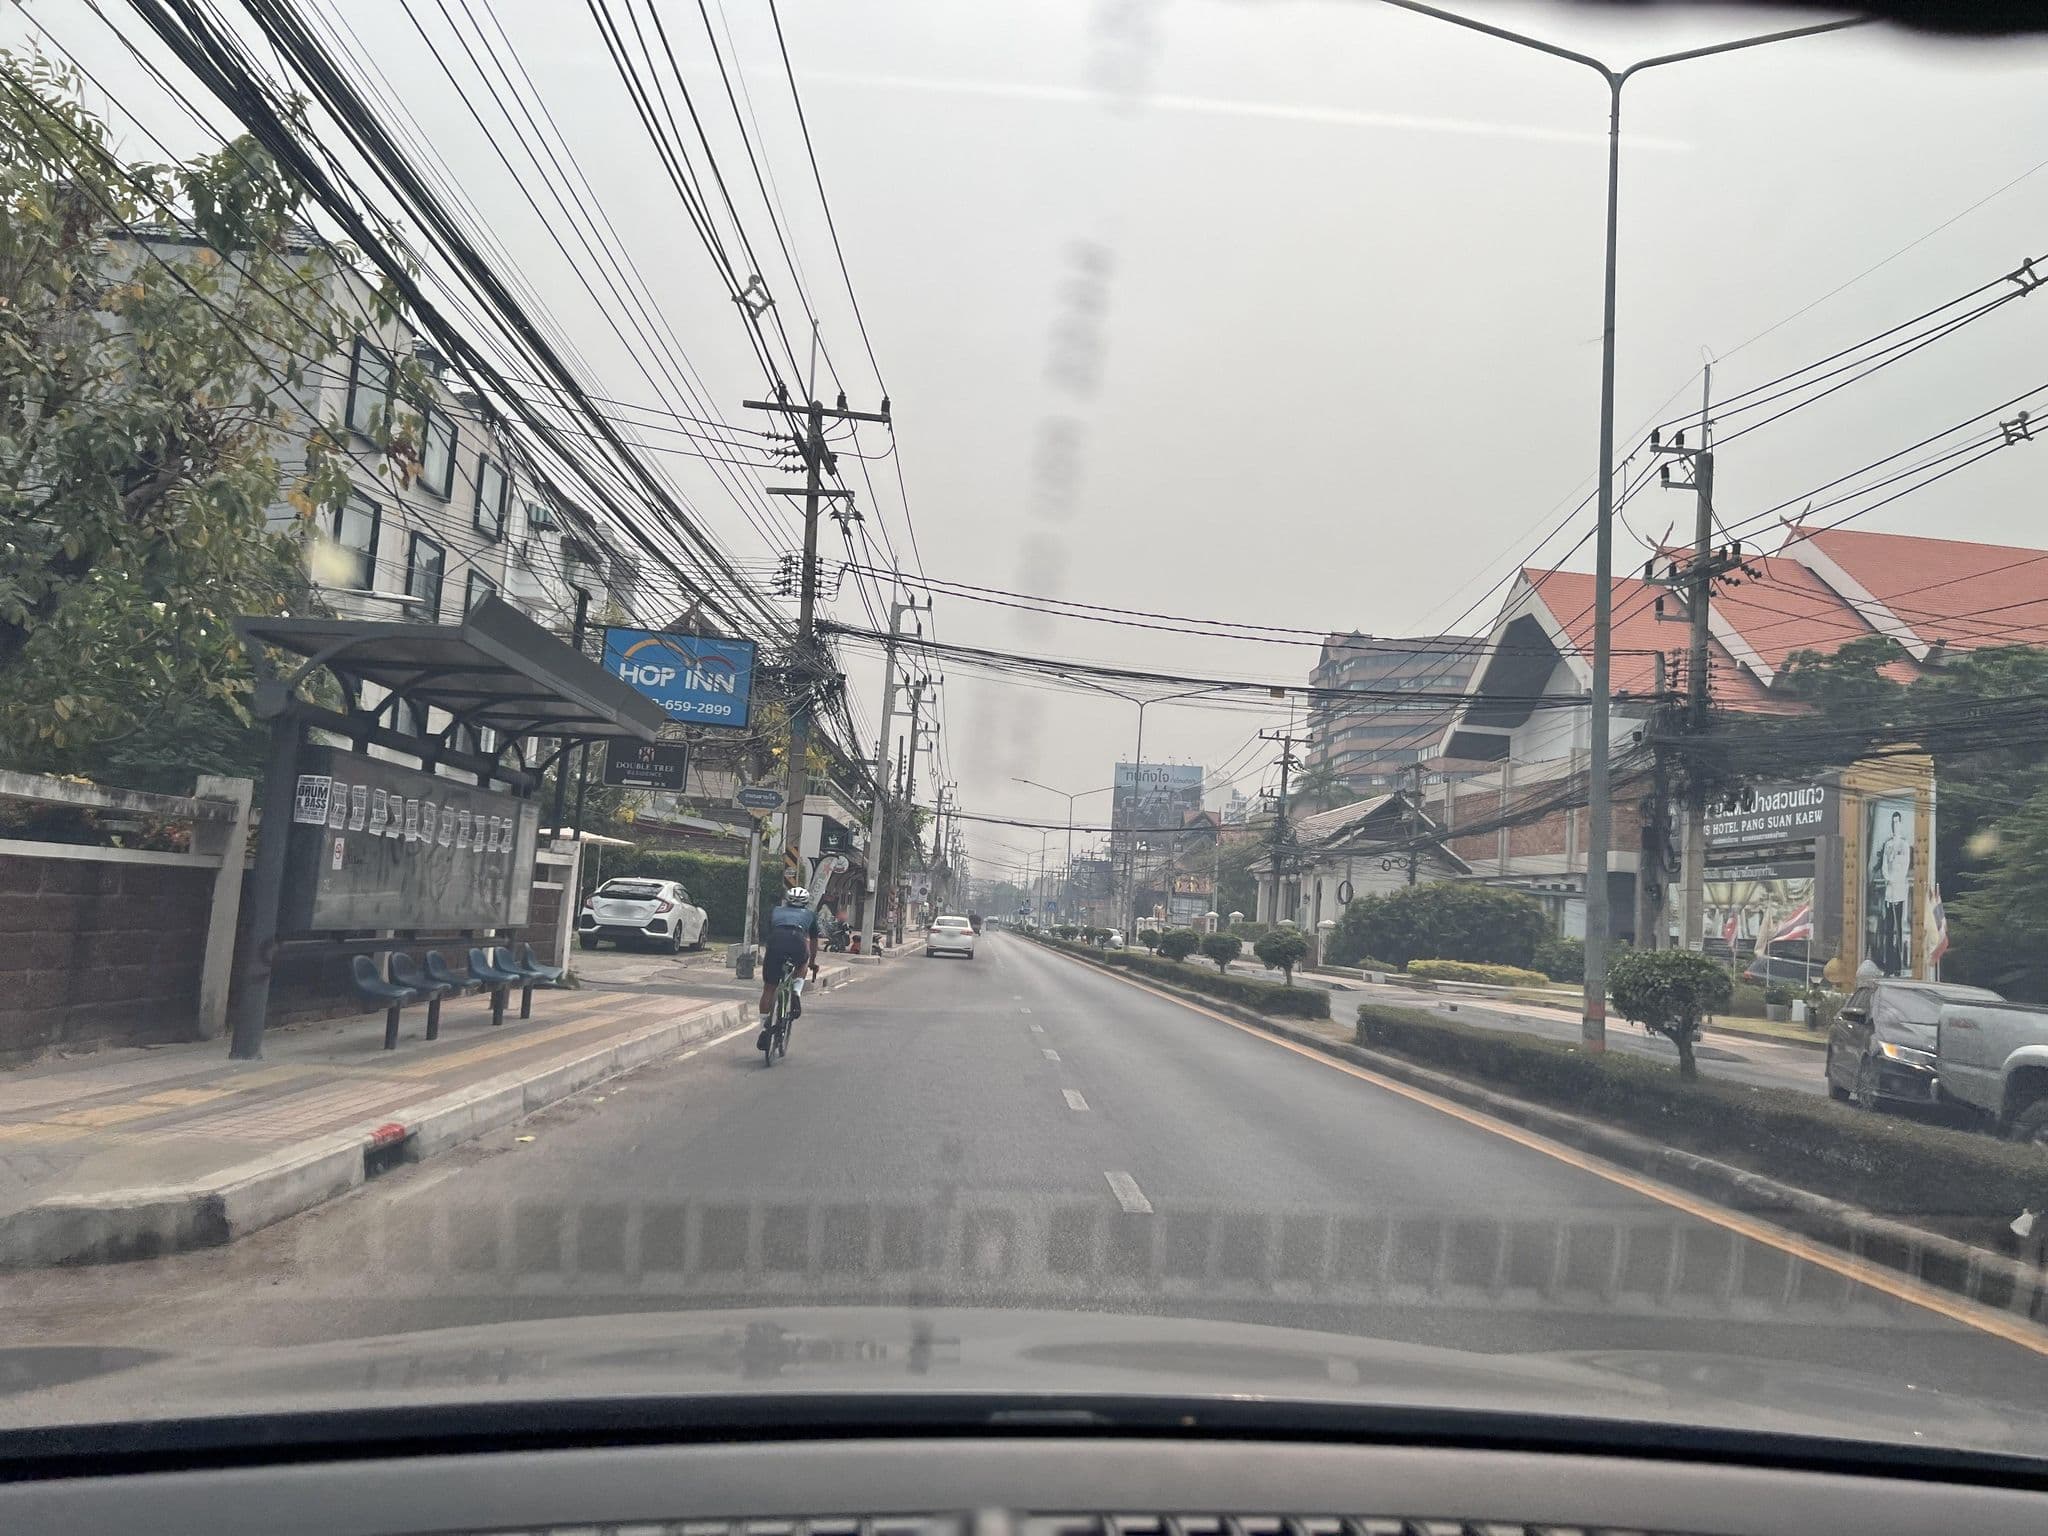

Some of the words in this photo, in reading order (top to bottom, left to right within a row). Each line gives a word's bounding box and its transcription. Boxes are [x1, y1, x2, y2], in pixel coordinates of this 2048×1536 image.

[618, 662, 676, 687] HOP
[684, 669, 736, 694] INN
[616, 761, 651, 770] DOUBLE
[653, 764, 674, 772] TREE
[298, 785, 328, 798] DRUM
[304, 797, 326, 809] BASS
[1712, 822, 1739, 835] HOTEL
[1741, 818, 1764, 832] PANG
[1767, 814, 1792, 828] SUAN
[1795, 810, 1824, 825] KAEW
